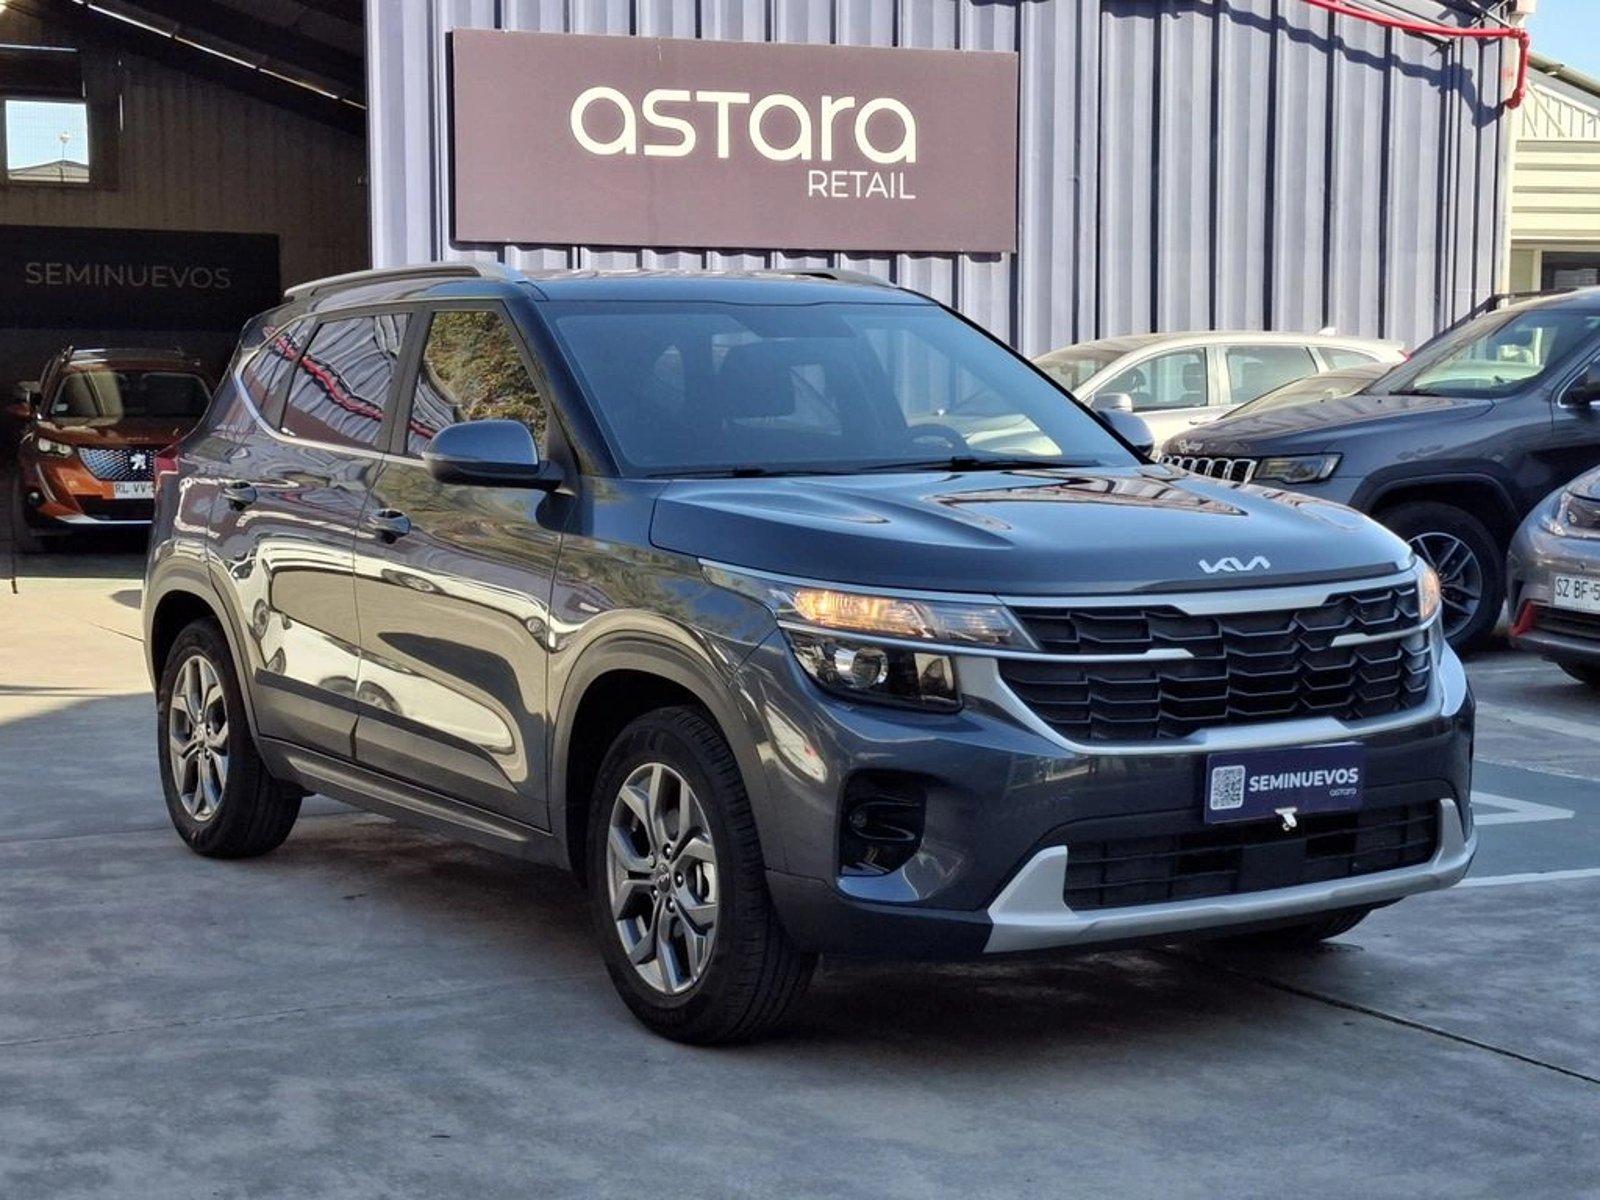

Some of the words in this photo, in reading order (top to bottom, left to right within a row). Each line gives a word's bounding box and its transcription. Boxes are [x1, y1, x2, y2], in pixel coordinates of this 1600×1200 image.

[570, 86, 917, 164] astara
[808, 169, 916, 200] RETAIL
[24, 261, 232, 290] SEMINUEVOS
[1556, 578, 1570, 598] SZ
[1249, 767, 1359, 793] SEMINUEVOS
